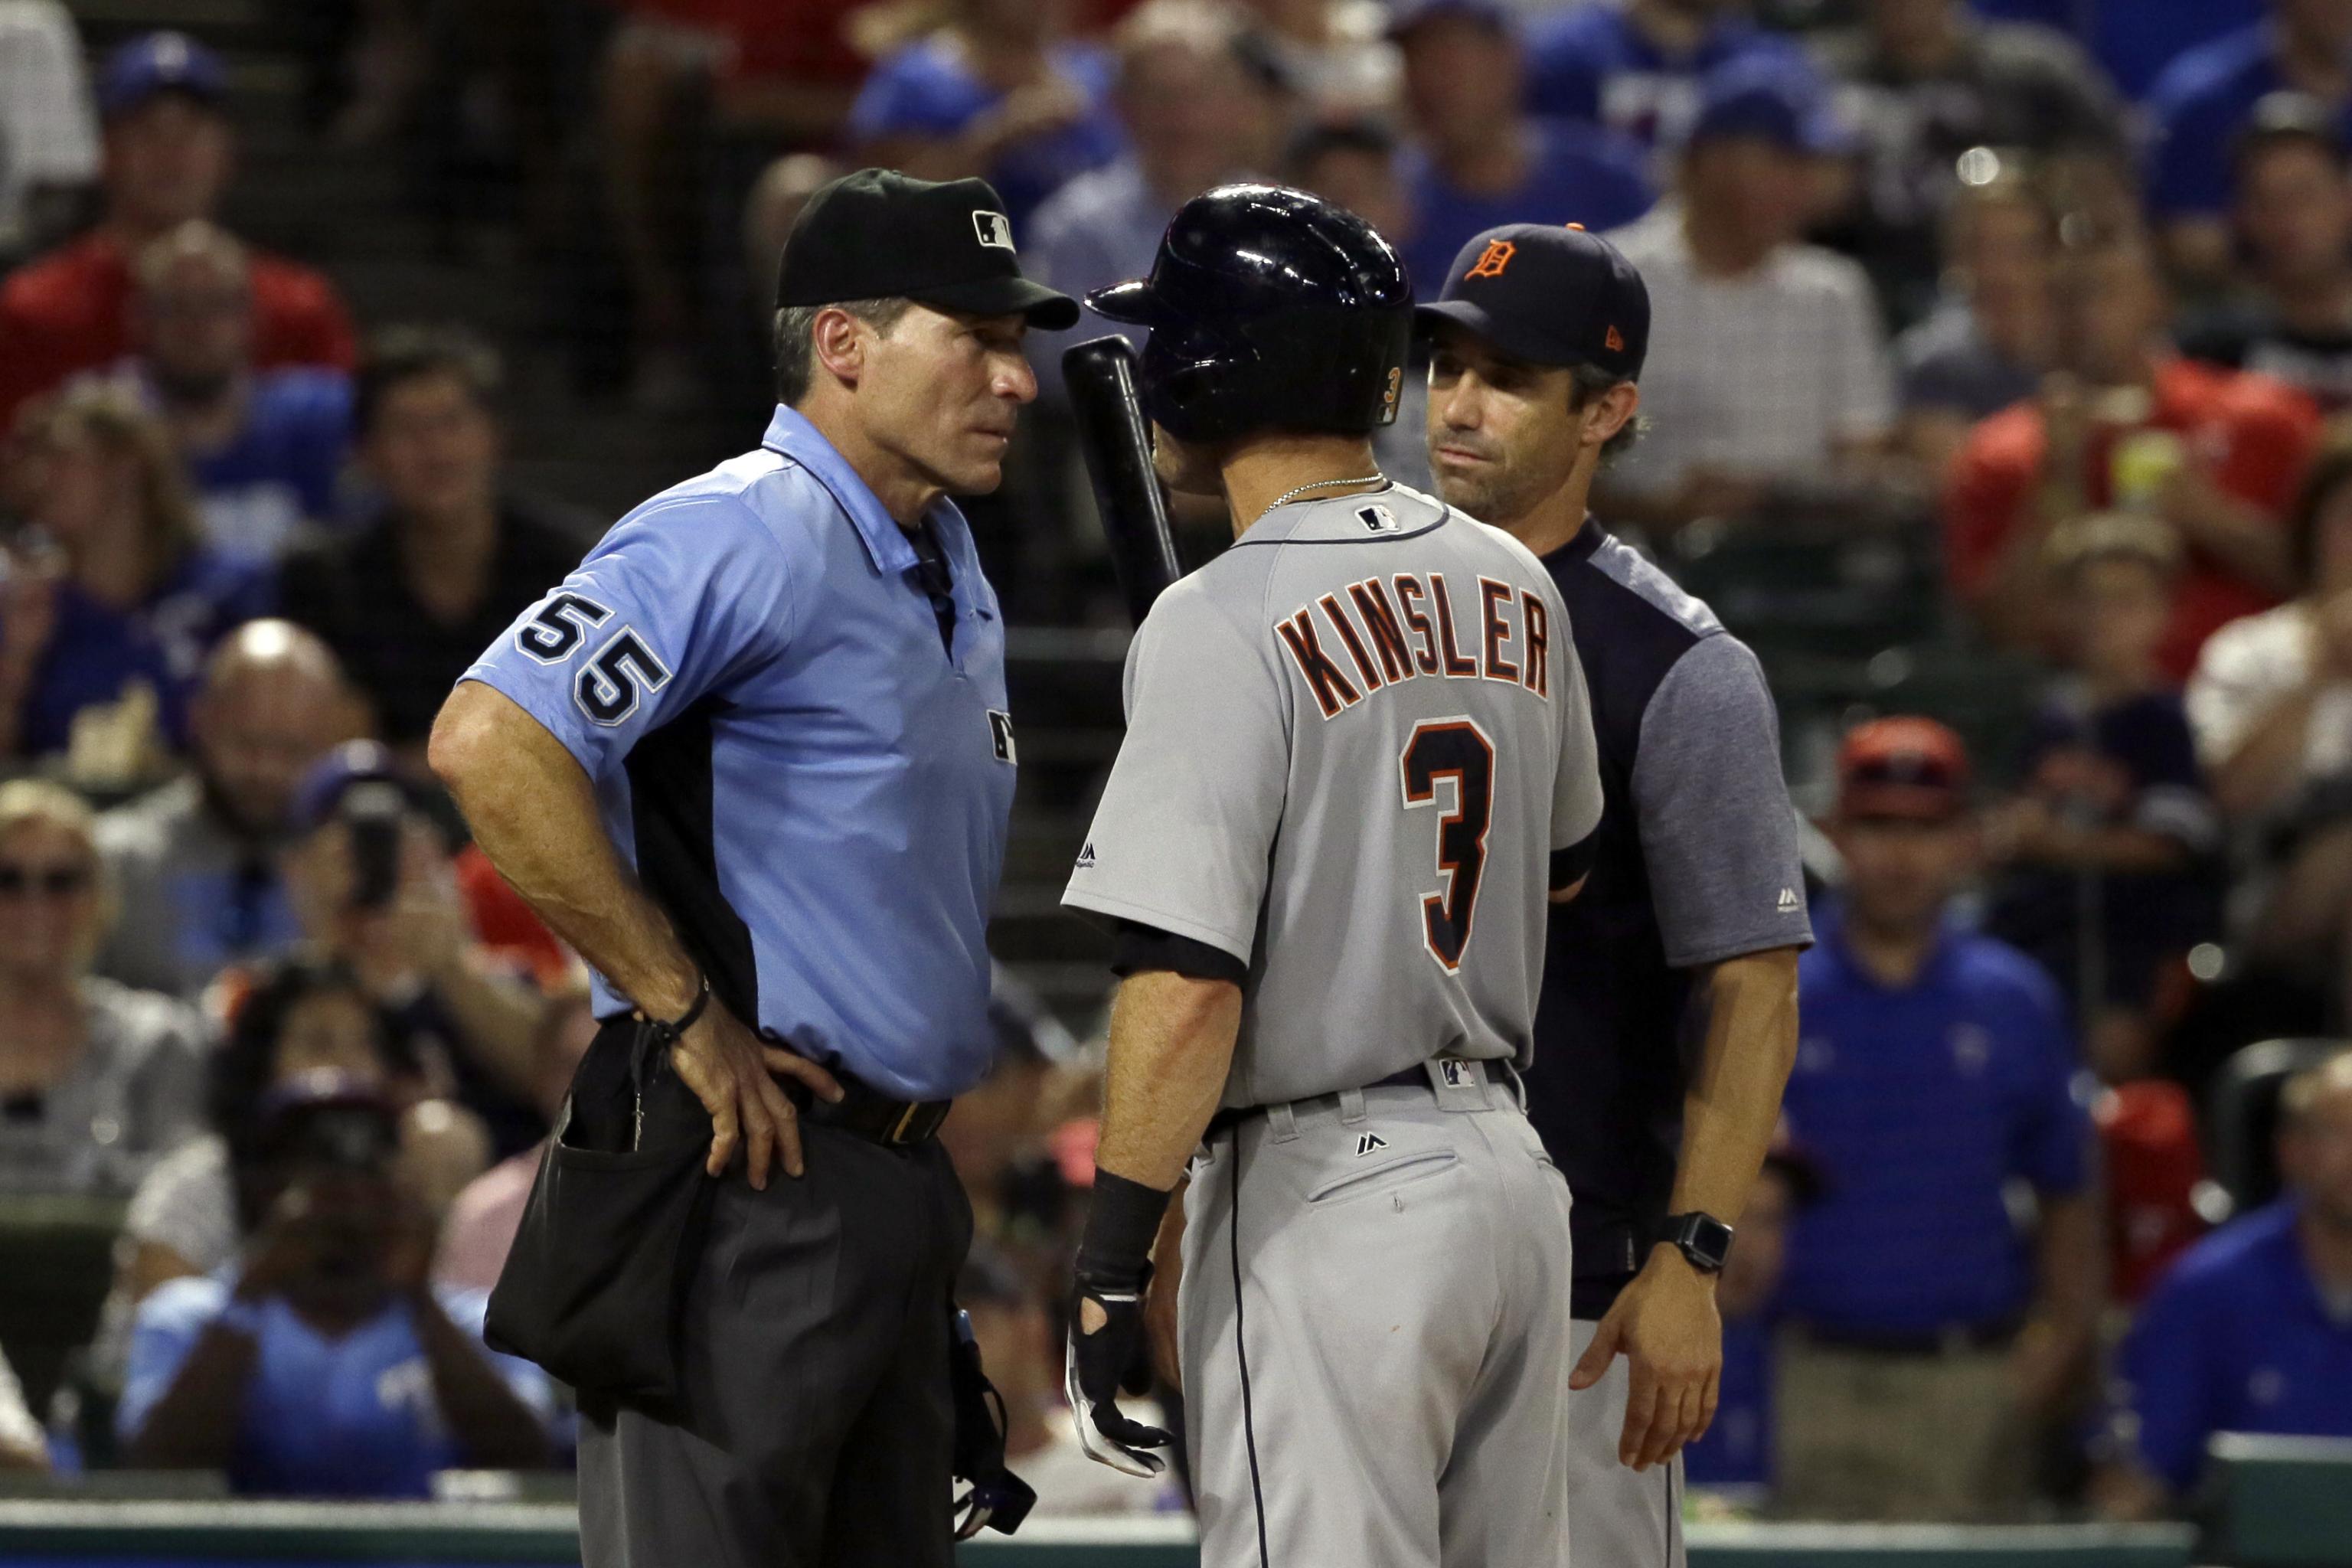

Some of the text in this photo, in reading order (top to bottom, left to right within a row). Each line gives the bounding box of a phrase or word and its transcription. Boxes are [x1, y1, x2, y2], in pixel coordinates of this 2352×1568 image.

[1464, 239, 1517, 281] D
[1384, 368, 1400, 403] 3
[514, 591, 673, 727] 55
[1274, 572, 1550, 720] KINSLER
[1398, 714, 1497, 977] 3
